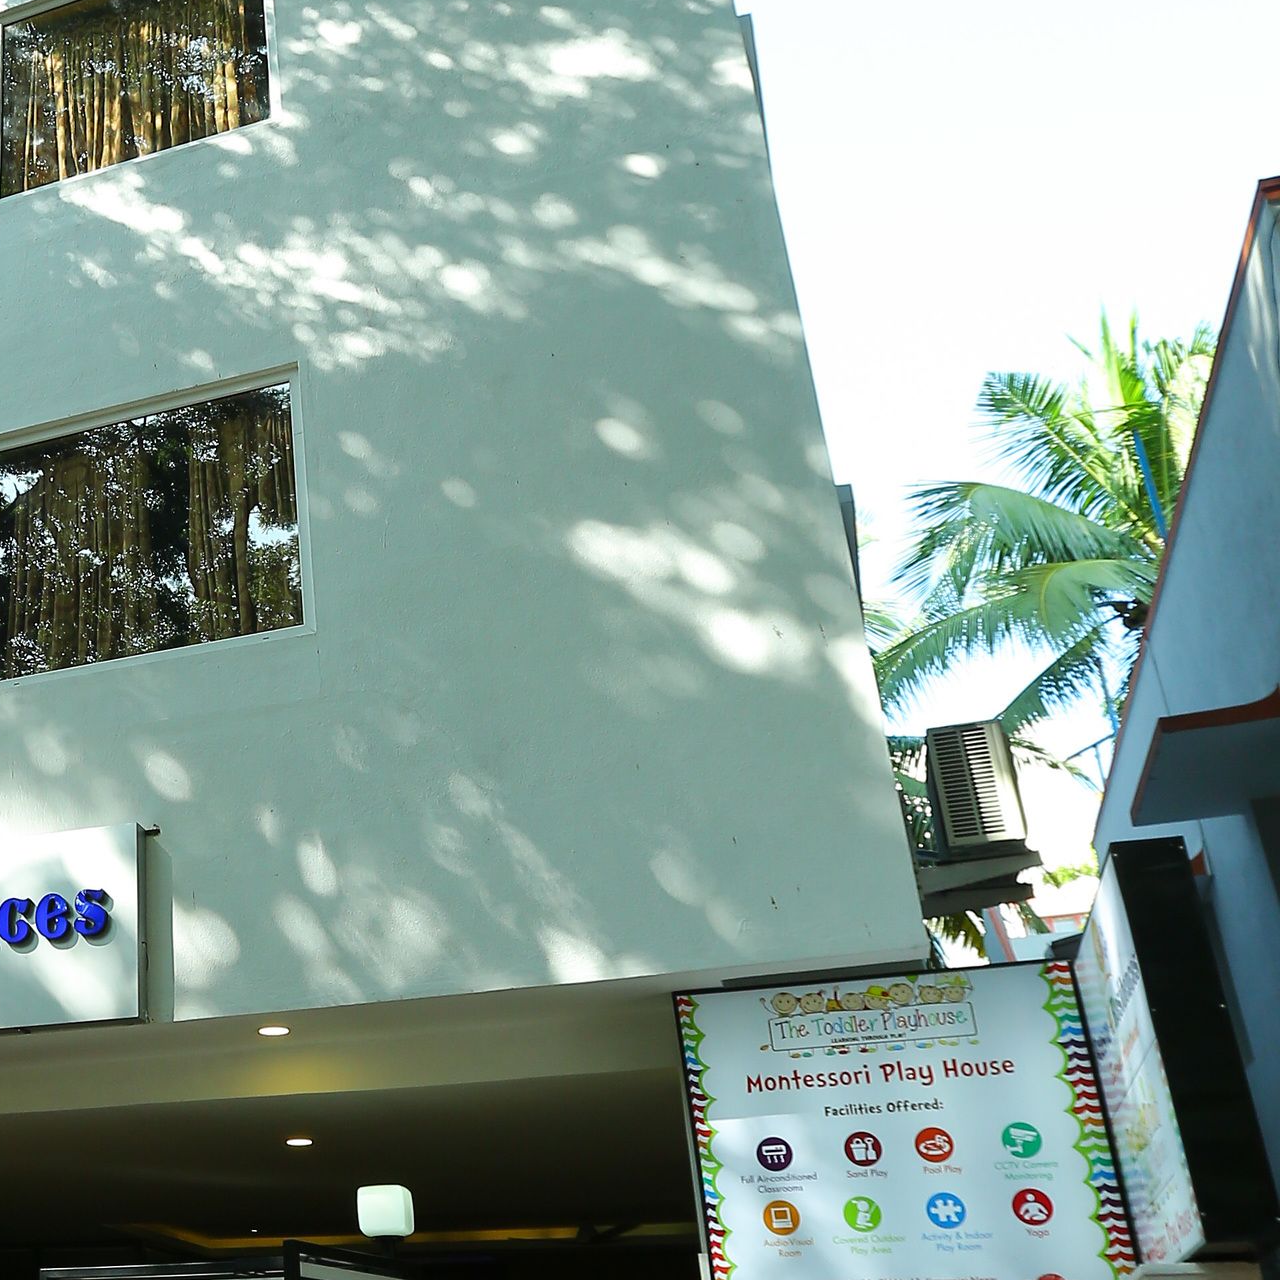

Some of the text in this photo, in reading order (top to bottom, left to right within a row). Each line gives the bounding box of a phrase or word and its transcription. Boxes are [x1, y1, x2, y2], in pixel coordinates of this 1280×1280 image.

[775, 1008, 968, 1041] The Toddler Playhouse
[746, 1058, 1016, 1094] Montessori Play House
[824, 1098, 945, 1117] Facilities Offered:
[923, 1165, 963, 1176] Pool Play
[994, 1161, 1059, 1171] CCTV Camera
[741, 1175, 755, 1184] Full
[846, 1169, 888, 1180] Sand Play
[1005, 1172, 1054, 1182] Monitoring
[757, 1185, 804, 1195] Classrooms
[921, 1230, 993, 1242] Activity & Indoor
[1025, 1228, 1050, 1239] Yoga
[832, 1234, 906, 1245] Covered Outdoor
[851, 1245, 892, 1256] Play Area
[936, 1241, 983, 1253] Play Room
[778, 1249, 802, 1258] Room
